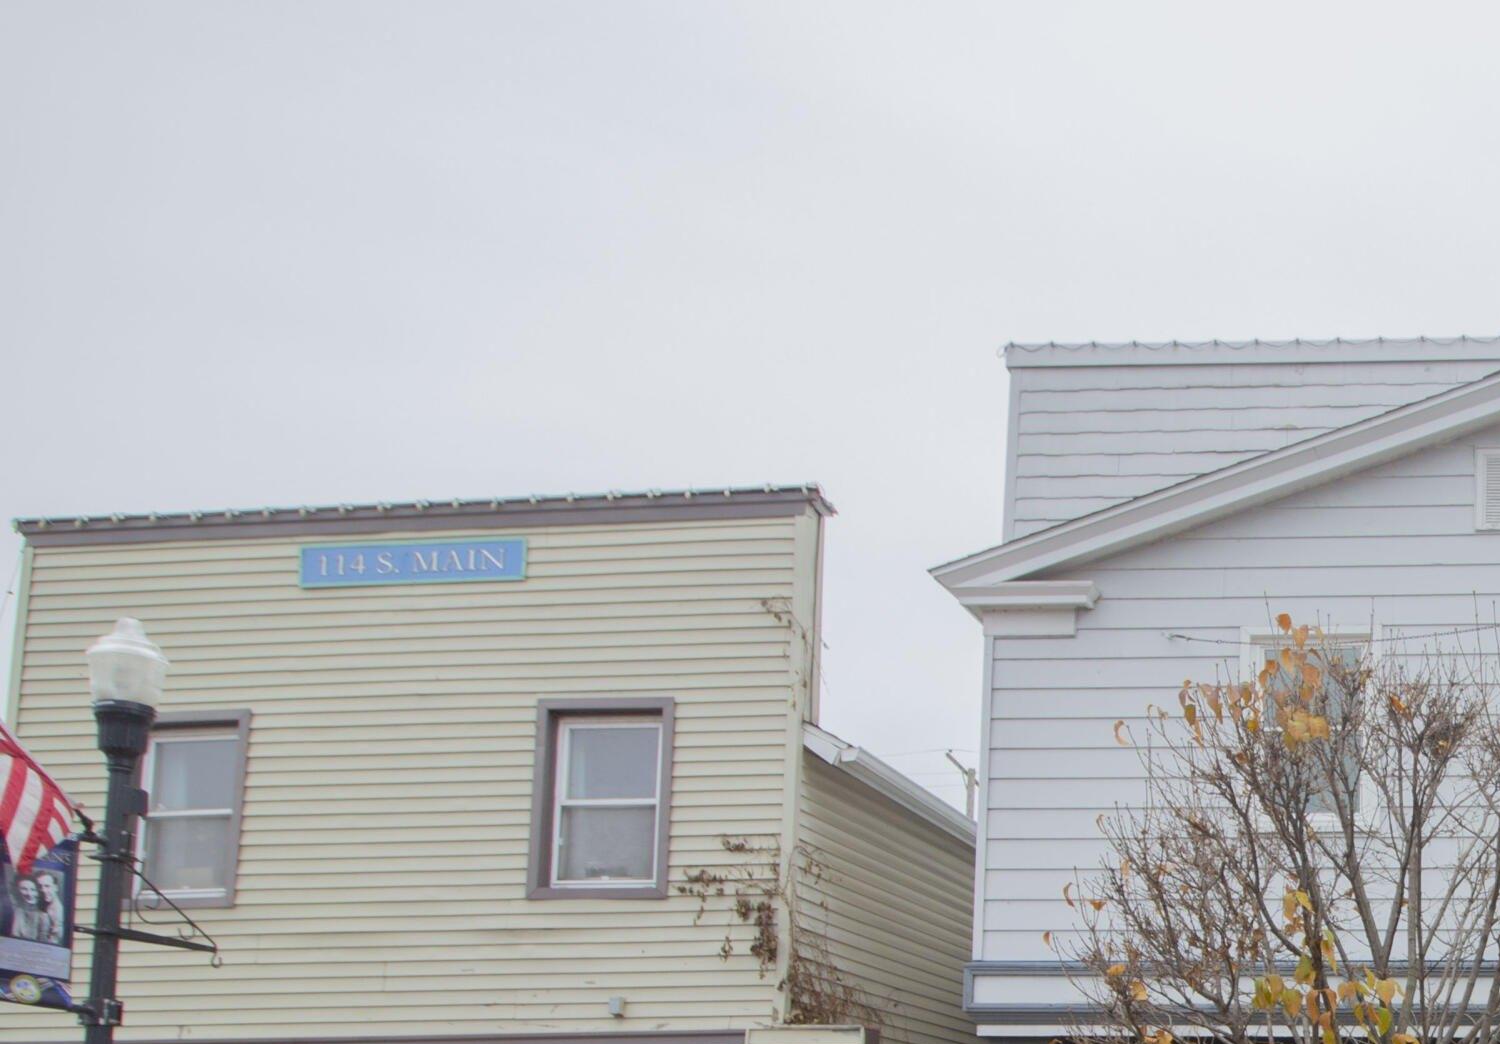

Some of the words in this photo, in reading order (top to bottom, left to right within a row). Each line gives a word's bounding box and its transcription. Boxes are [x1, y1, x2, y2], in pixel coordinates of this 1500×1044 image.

[319, 552, 366, 576] 114
[375, 551, 400, 574] S.
[413, 548, 505, 573] MAIN
